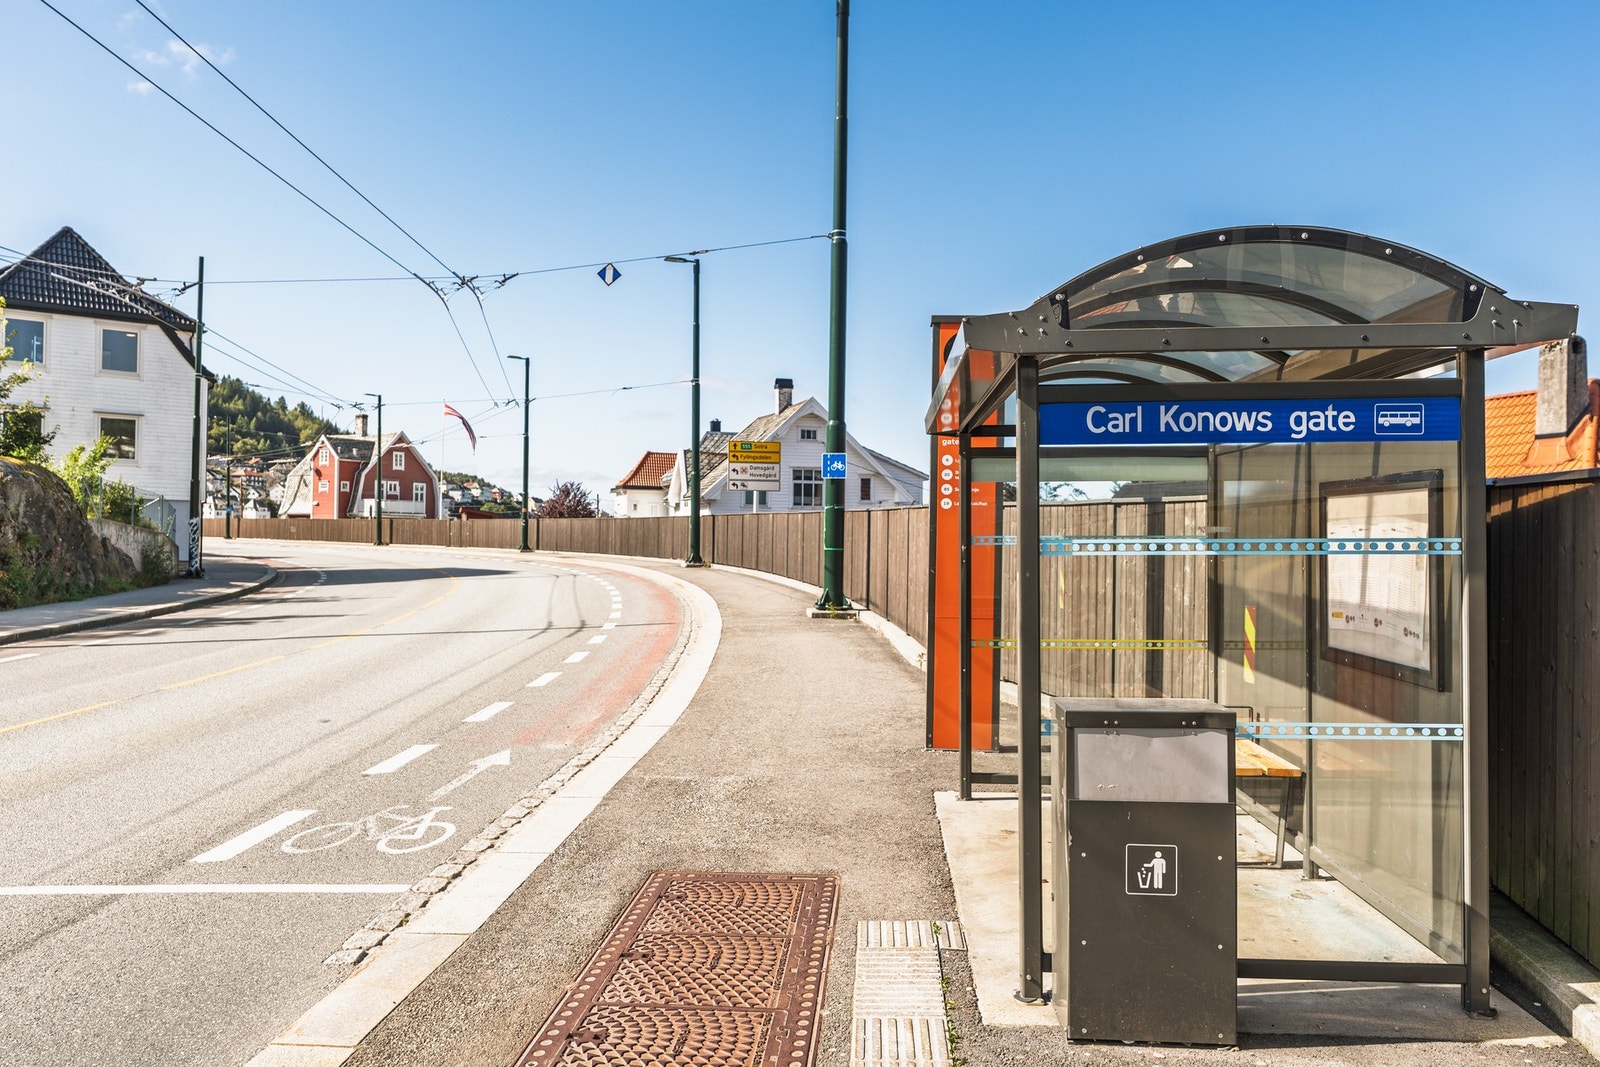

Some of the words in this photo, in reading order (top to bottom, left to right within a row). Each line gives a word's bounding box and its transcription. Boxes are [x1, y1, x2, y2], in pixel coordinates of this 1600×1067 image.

[1086, 405, 1142, 434] Carl
[1160, 404, 1273, 433] Konows
[1289, 403, 1356, 439] gate
[740, 453, 772, 461] Fyllingsdalen
